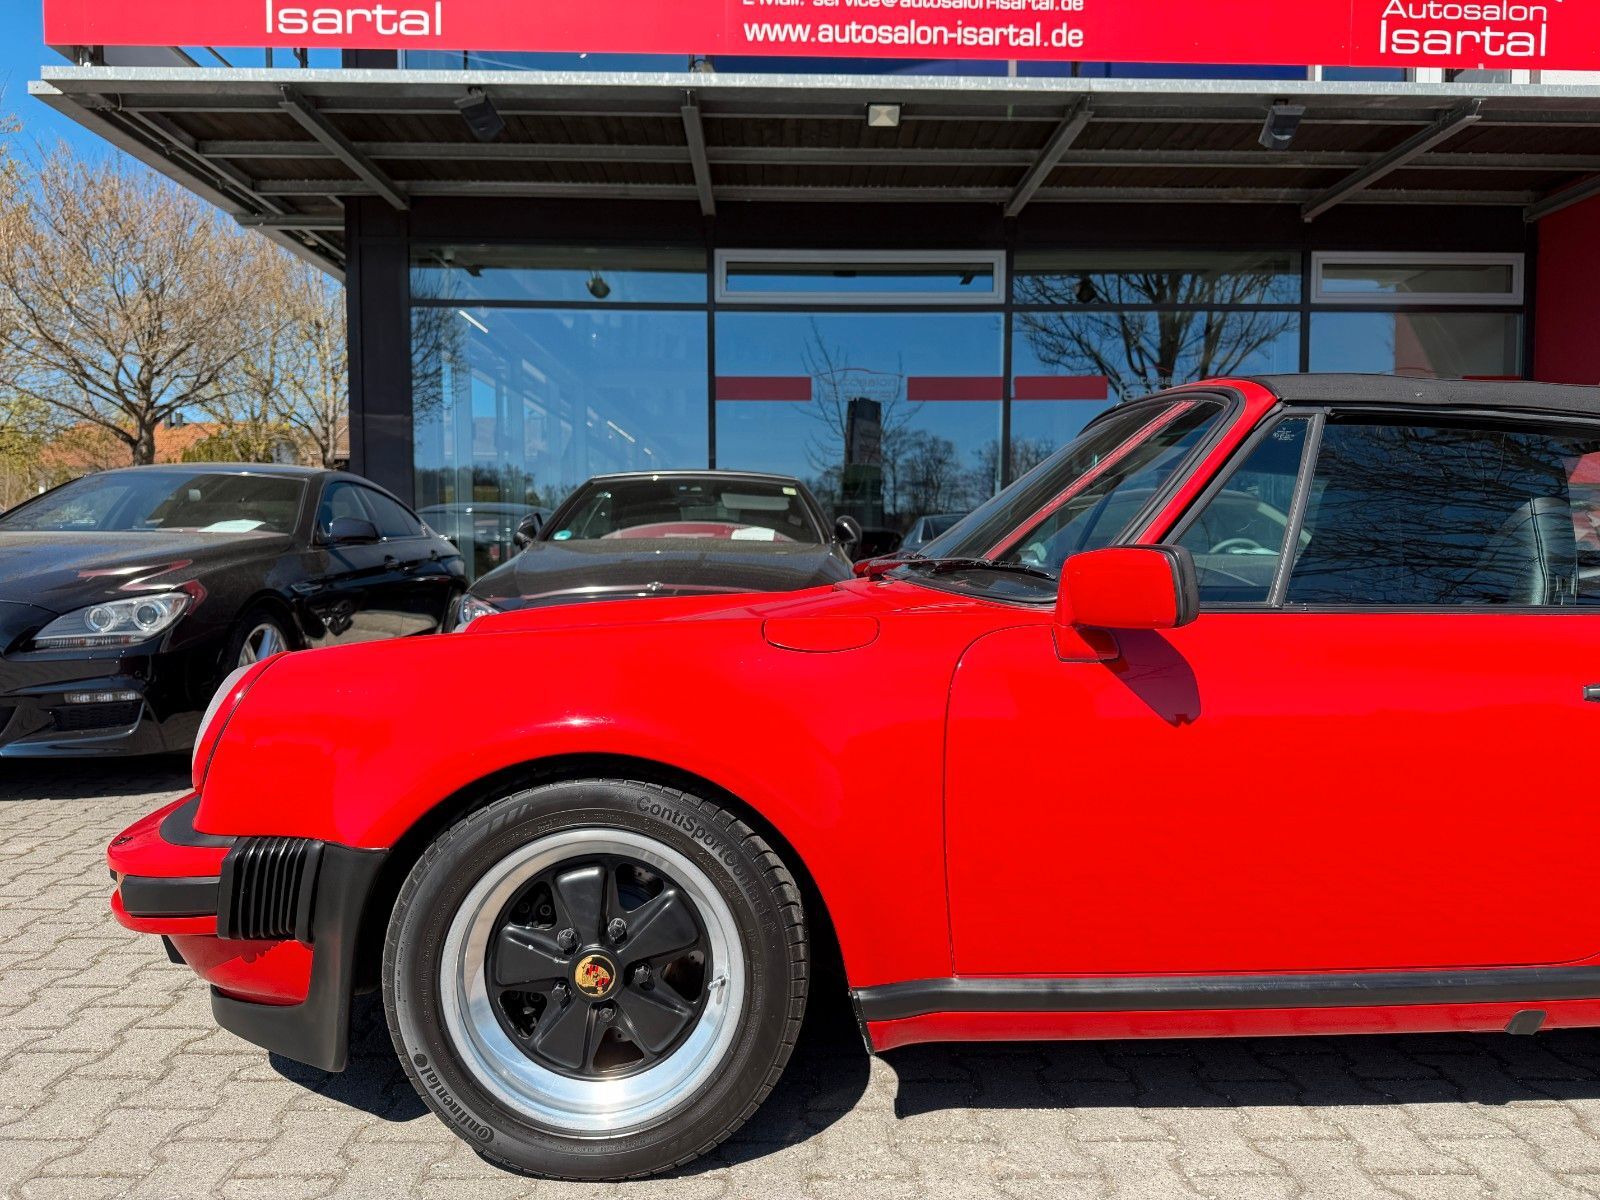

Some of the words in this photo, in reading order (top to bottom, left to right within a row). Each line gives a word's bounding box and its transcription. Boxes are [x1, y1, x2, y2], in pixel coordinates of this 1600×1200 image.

[265, 0, 442, 36] Isartal
[1382, 0, 1548, 21] Autosalon
[743, 19, 1084, 48] www.autosalon-isartal.de
[1379, 19, 1547, 57] Isartal
[420, 1066, 495, 1143] Continental
